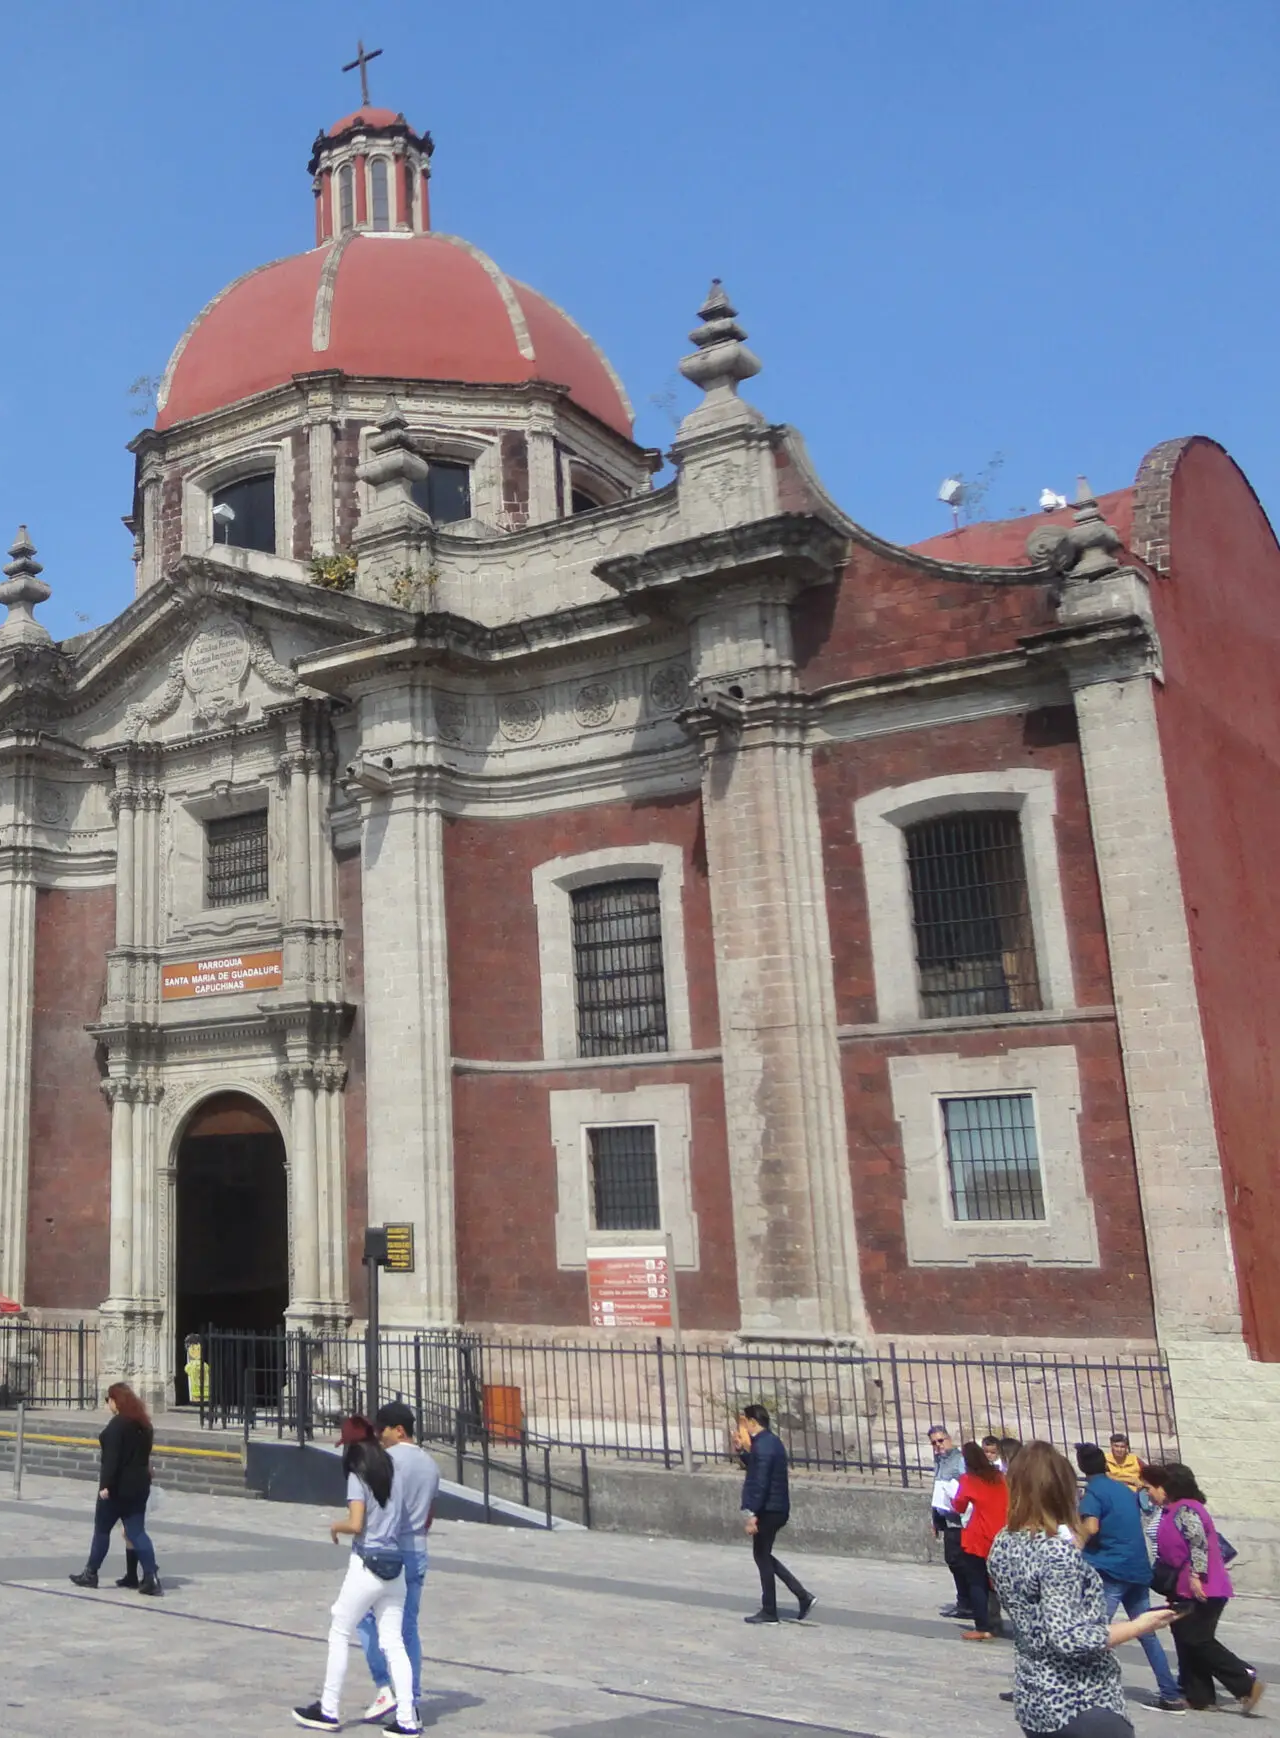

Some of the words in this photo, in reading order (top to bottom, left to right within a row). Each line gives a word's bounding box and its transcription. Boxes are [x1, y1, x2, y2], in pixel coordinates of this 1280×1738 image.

[198, 958, 243, 970] PARROQUIA
[165, 976, 189, 986] SANTA
[191, 974, 216, 983] MARIA
[218, 971, 229, 979] DE
[231, 965, 281, 978] GUADALUPE,
[195, 980, 244, 993] CAPUCHINAS
